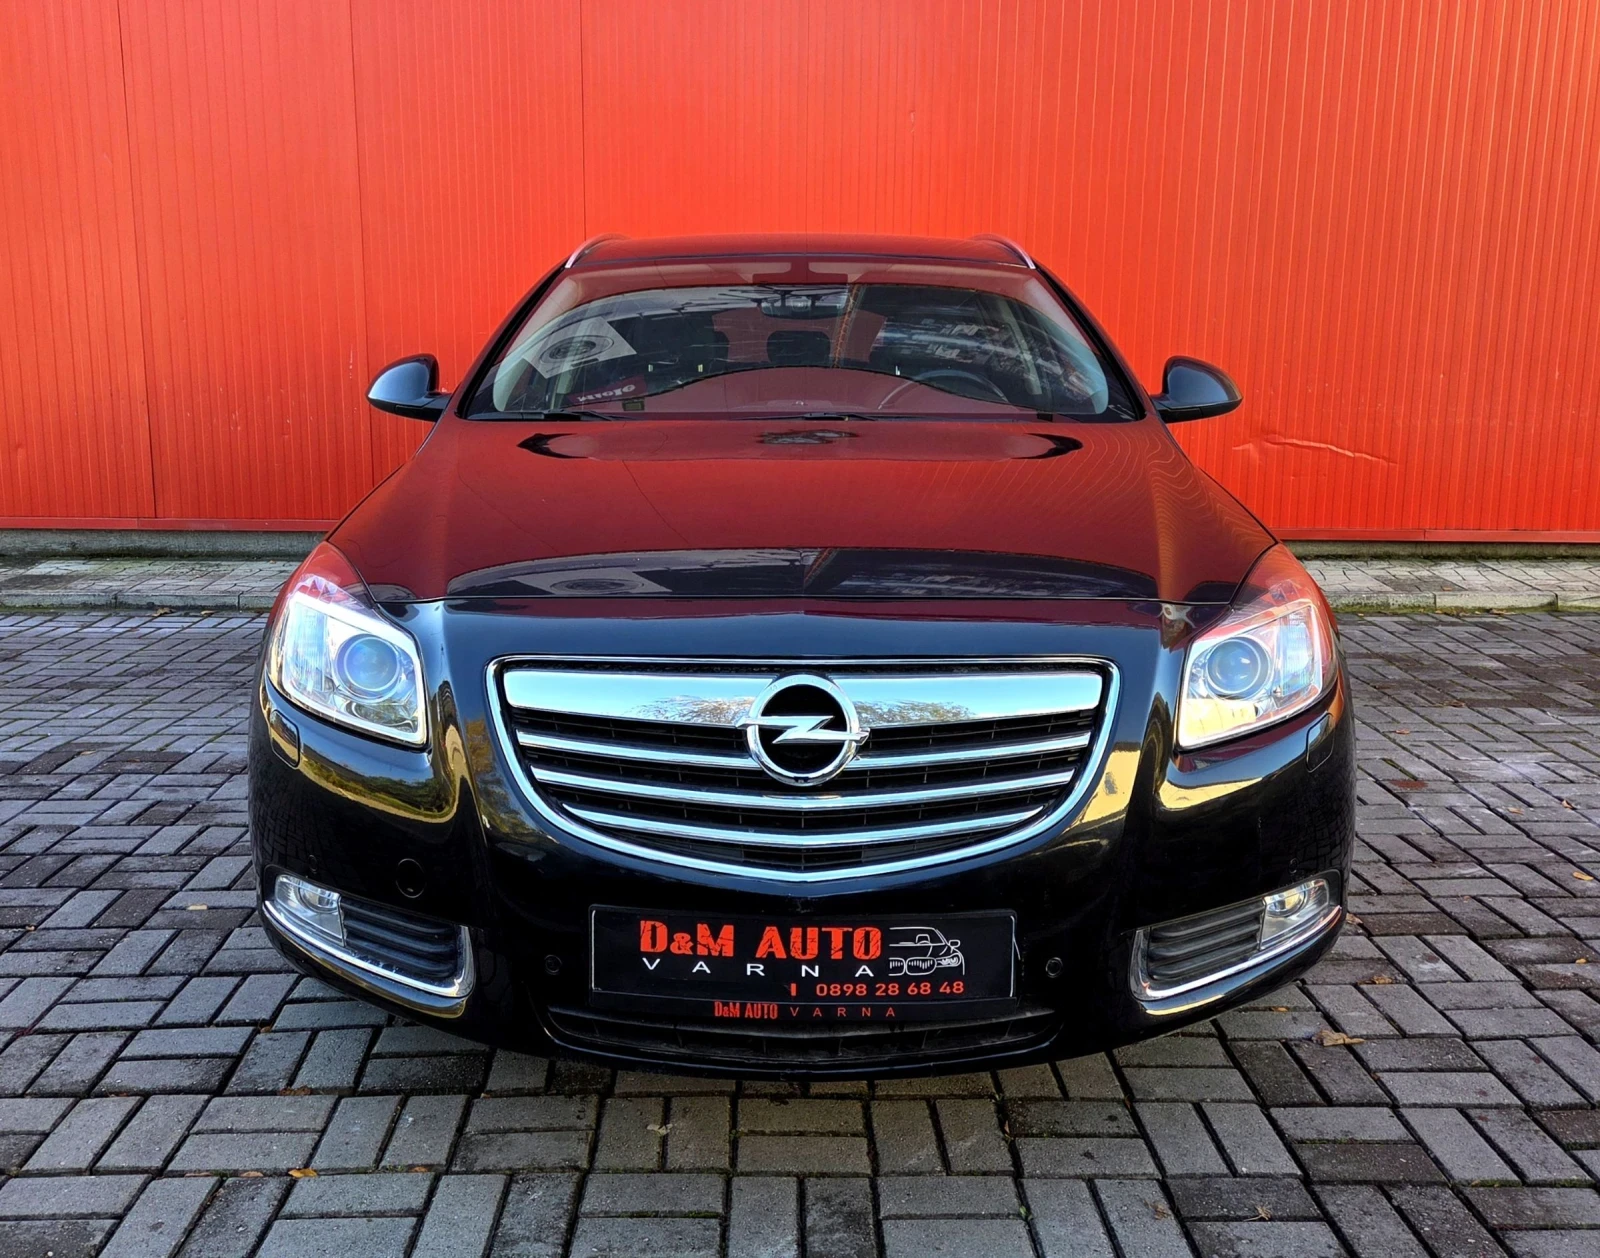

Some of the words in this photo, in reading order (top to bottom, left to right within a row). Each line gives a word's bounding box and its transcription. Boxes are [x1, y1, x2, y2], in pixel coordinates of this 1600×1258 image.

[639, 920, 735, 957] D&M
[755, 925, 882, 960] AUTO
[642, 957, 875, 978] VARNA
[815, 983, 867, 997] 0898
[875, 982, 900, 996] 28
[907, 981, 931, 995] 68
[939, 980, 965, 994] 48
[714, 1000, 741, 1019] D&M
[744, 1002, 779, 1020] AUTO
[789, 1006, 896, 1018] VARNA
